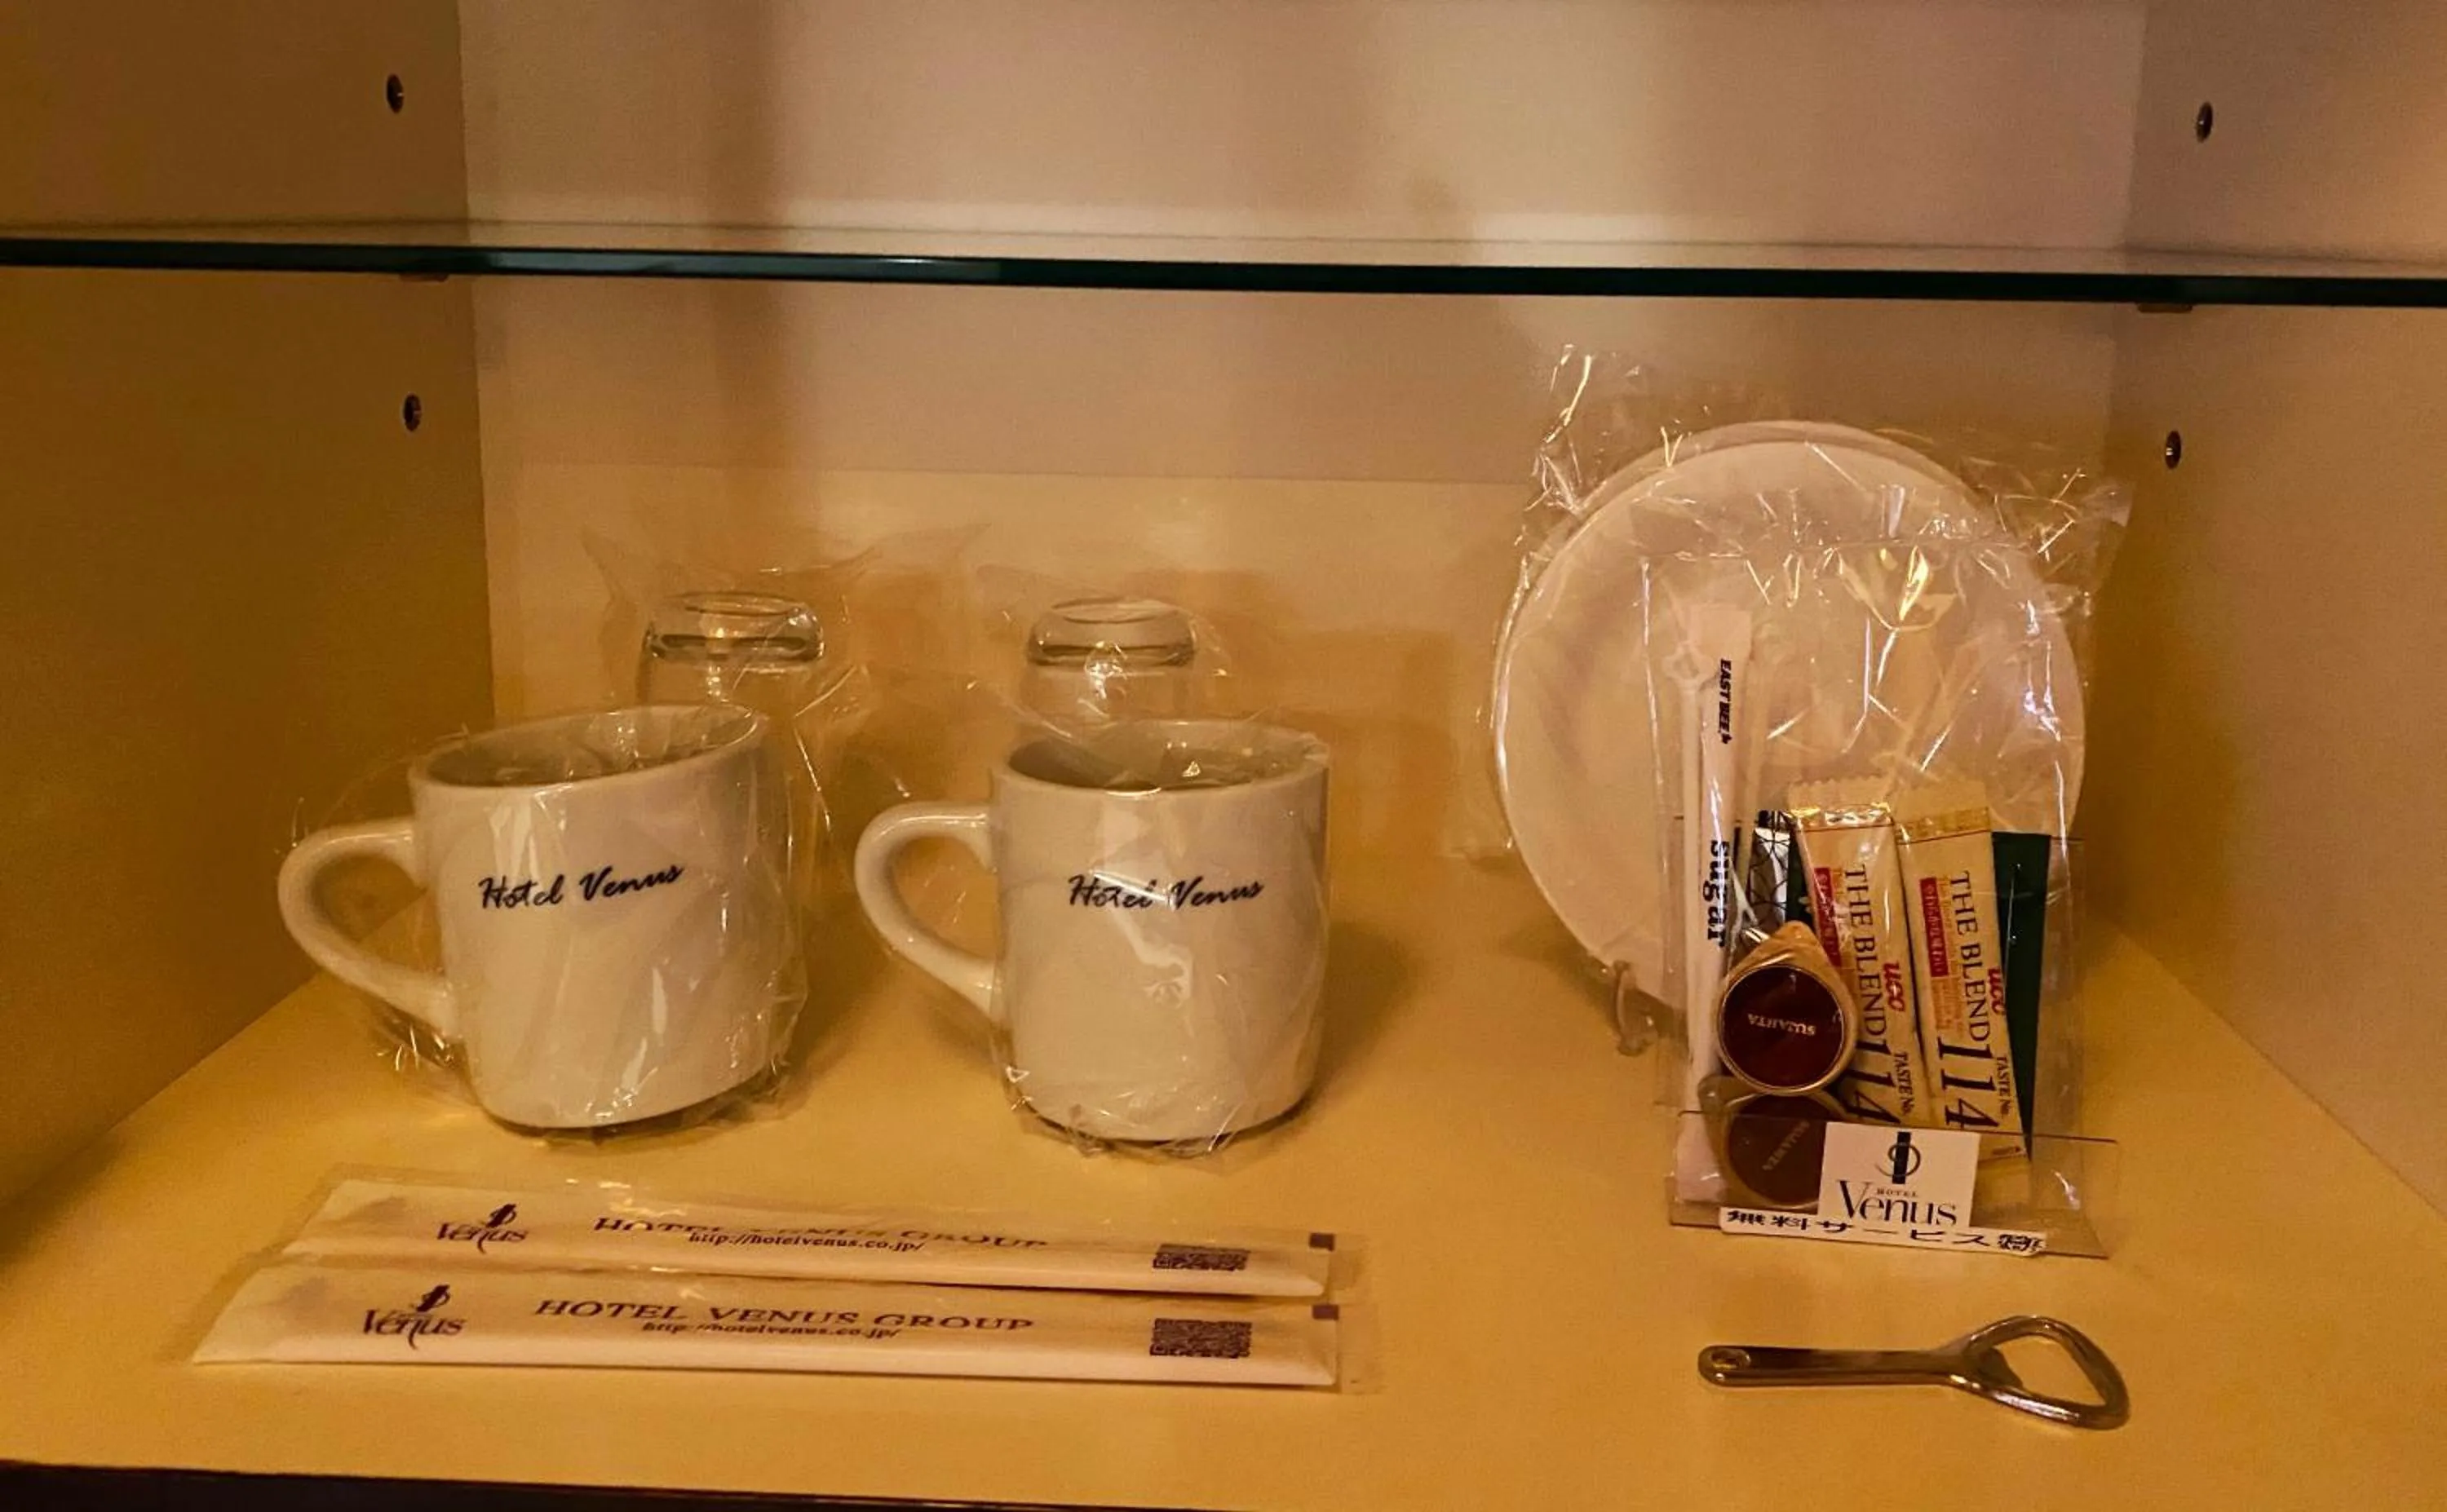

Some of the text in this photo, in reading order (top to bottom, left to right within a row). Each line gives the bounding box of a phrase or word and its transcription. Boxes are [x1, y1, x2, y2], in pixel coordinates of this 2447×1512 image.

[1719, 659, 1732, 701] EAST
[478, 865, 684, 909] Hotel Venus
[1068, 873, 1264, 909] Hotel Venus
[1702, 840, 1730, 948] sugar
[1845, 864, 1874, 927] THE
[1950, 870, 1978, 935] THE
[1854, 936, 1887, 1037] BLEND
[1960, 942, 1991, 1041] BLEND
[1840, 1039, 1901, 1125] 114
[1894, 1051, 1914, 1095] TASTE
[1936, 1036, 2000, 1131] 114
[1996, 1056, 2011, 1097] TASTE
[1838, 1180, 1957, 1226] Venus
[1876, 1187, 1918, 1197] HOTEL
[436, 1222, 529, 1253] Venus
[363, 1307, 467, 1350] Venus
[535, 1299, 1033, 1330] HOTEL VENUS GROUP
[643, 1321, 902, 1340] http//hotelvenus.co.jp/
